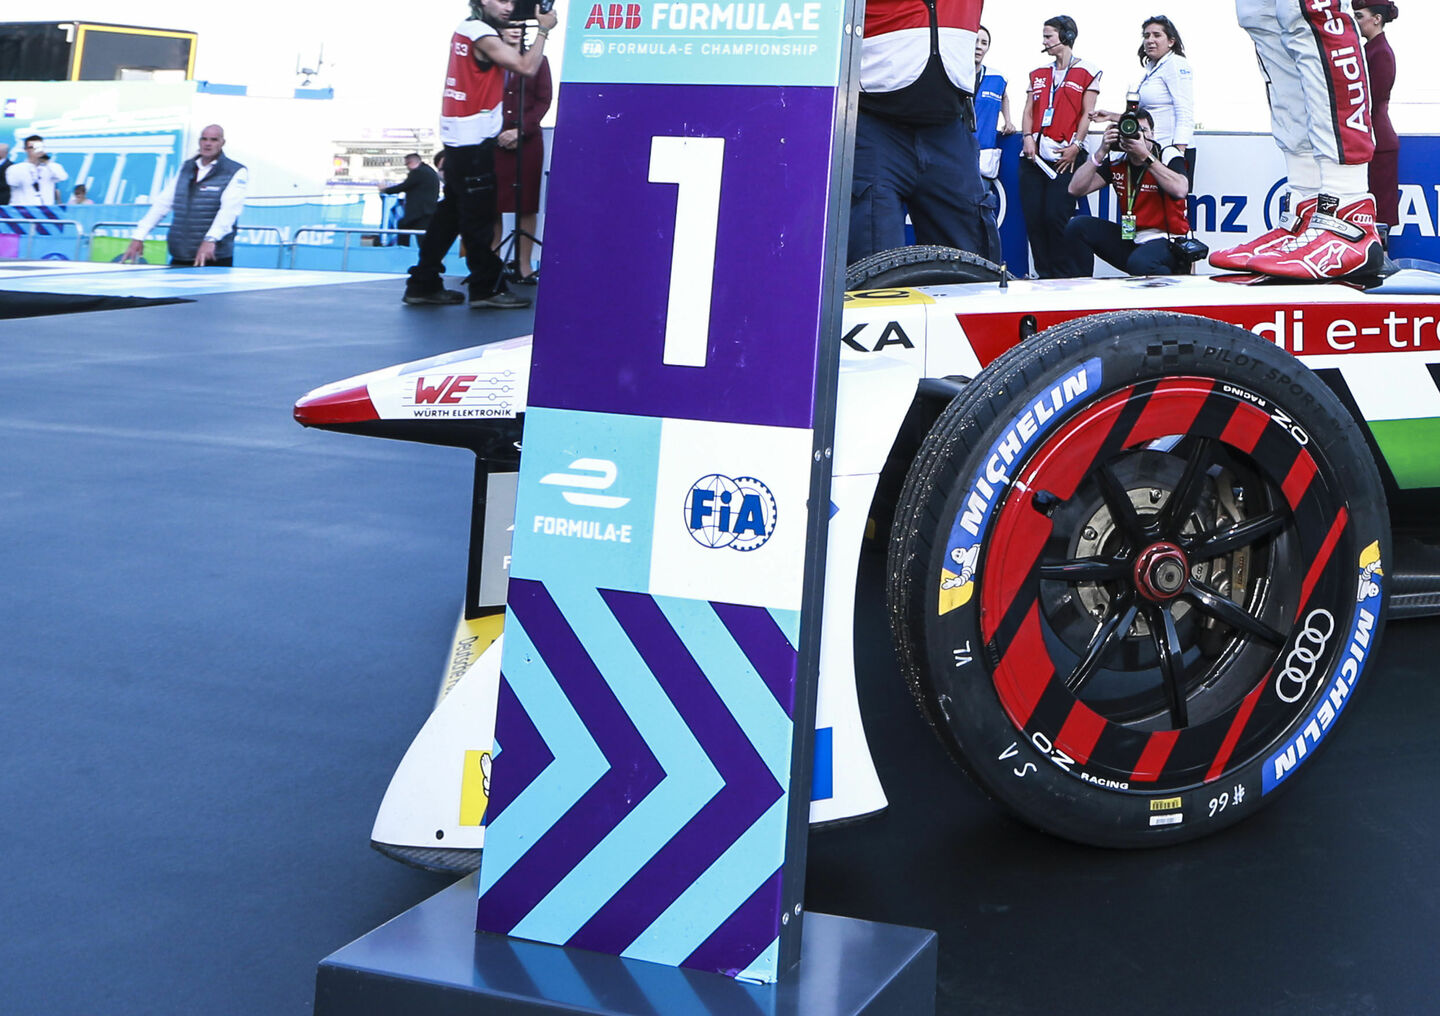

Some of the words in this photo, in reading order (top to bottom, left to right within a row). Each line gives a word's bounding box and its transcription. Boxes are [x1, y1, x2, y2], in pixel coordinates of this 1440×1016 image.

[584, 3, 642, 30] ABB
[608, 42, 693, 56] FORMULA-E
[700, 43, 818, 57] CHAMPIONSHIP
[1331, 45, 1369, 134] Audi
[648, 136, 725, 368] 1
[1222, 384, 1266, 407] RACING
[413, 408, 450, 417] WÜRTH
[452, 408, 512, 417] ELEKTRONIK
[959, 369, 1088, 536] MICHELIN
[1274, 608, 1375, 780] MICHELIN
[1081, 772, 1129, 790] RACING
